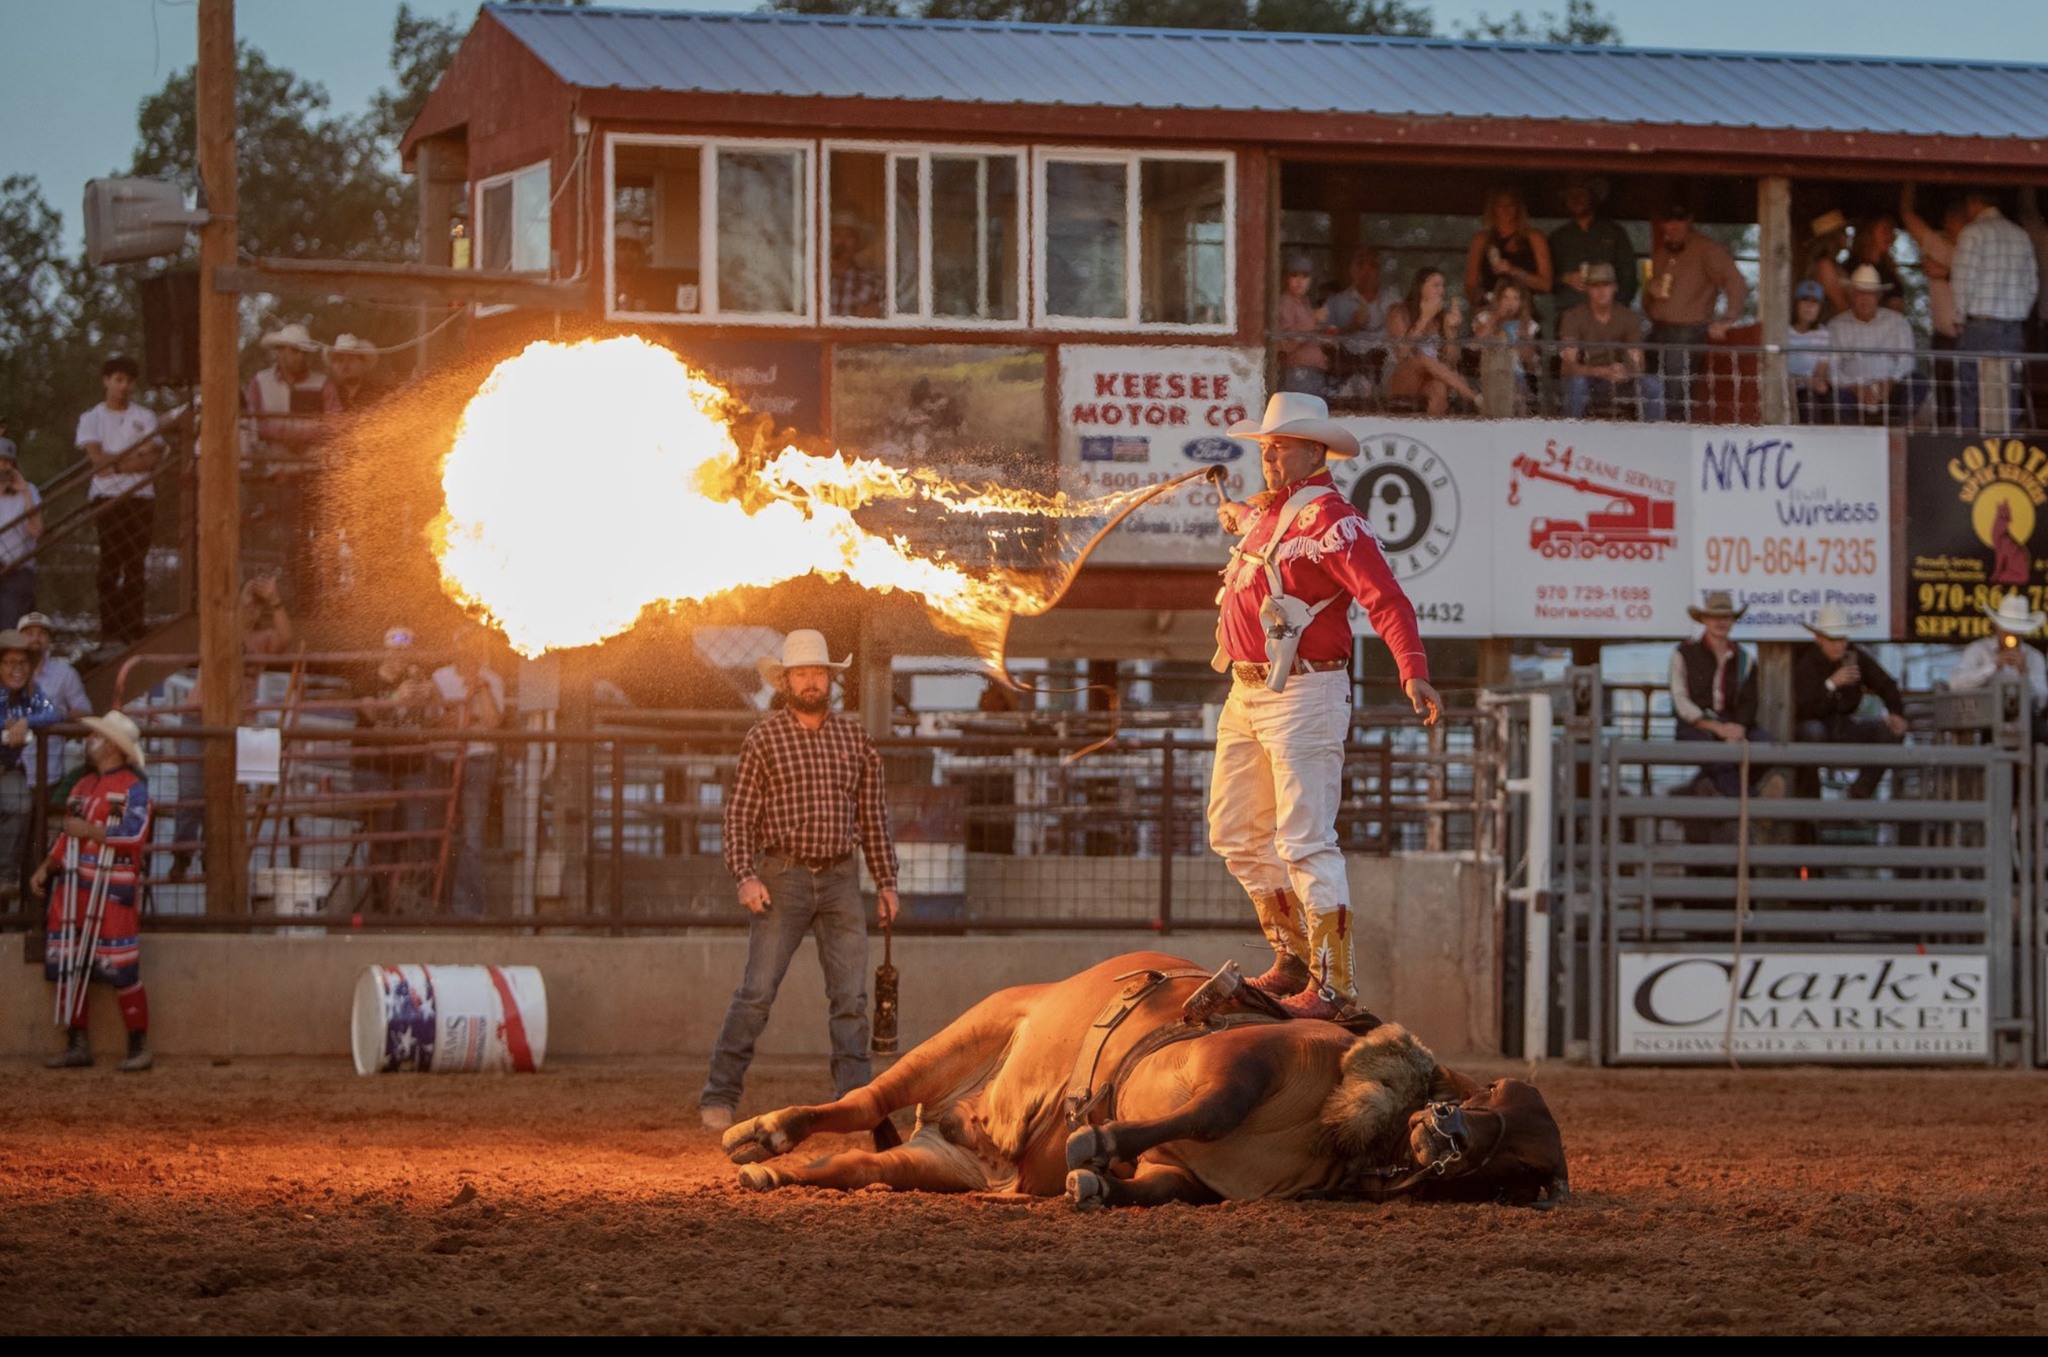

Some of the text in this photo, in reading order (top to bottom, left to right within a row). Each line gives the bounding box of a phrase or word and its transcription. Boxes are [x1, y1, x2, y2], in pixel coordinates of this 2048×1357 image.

[1093, 372, 1230, 400] KEESEE
[1073, 402, 1187, 427] MOTOR
[1702, 438, 1802, 491] NNTC
[1776, 498, 1880, 527] Wireless
[1705, 536, 1877, 576] 970-864-7335
[1788, 588, 1820, 606] Cell
[1825, 588, 1877, 606] Phone
[1625, 604, 1653, 620] CO
[1634, 957, 1983, 1027] Clark's
[1738, 1006, 1982, 1029] MARKET
